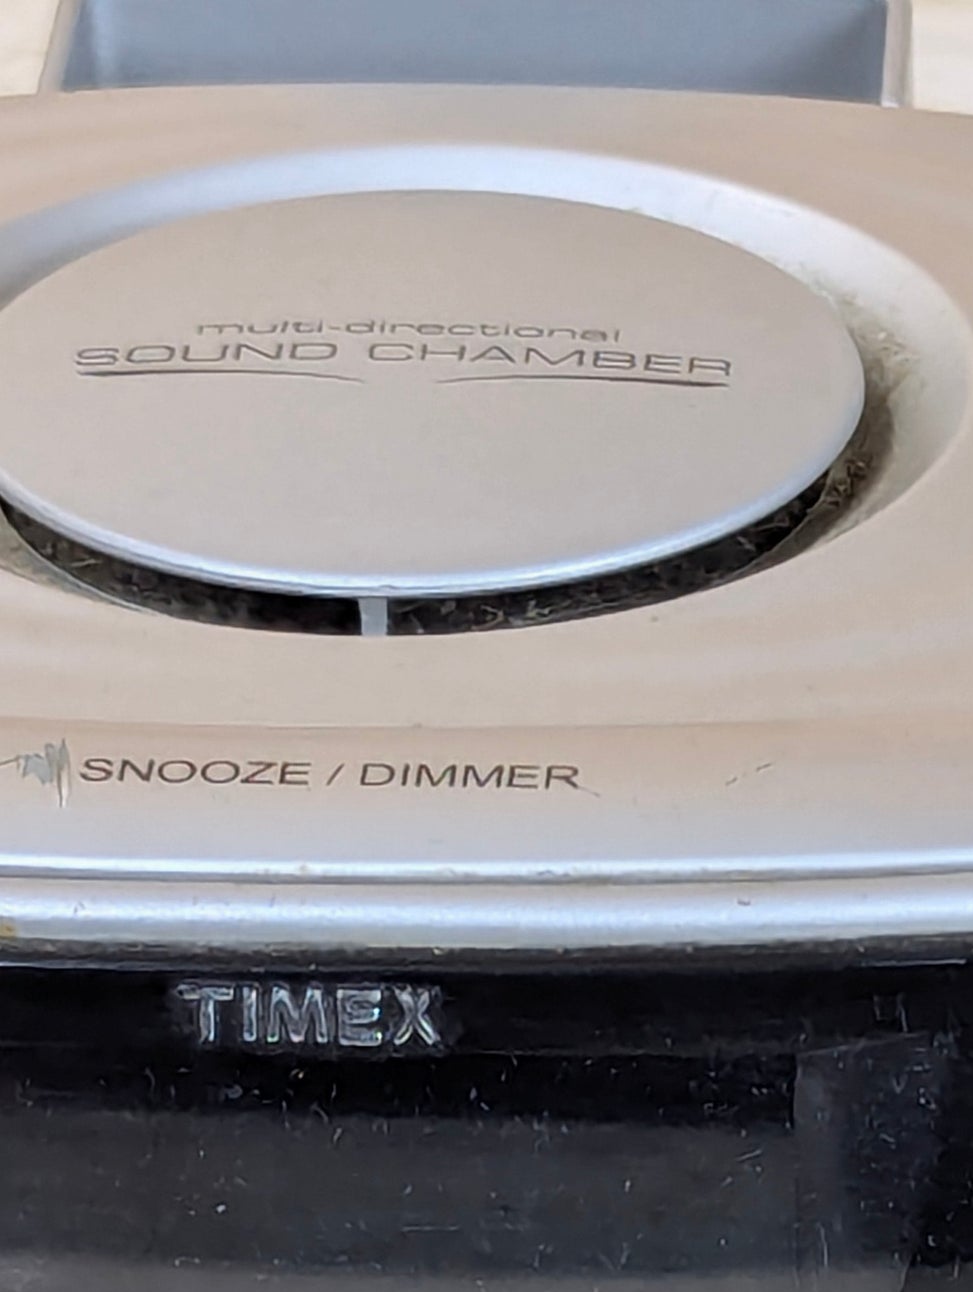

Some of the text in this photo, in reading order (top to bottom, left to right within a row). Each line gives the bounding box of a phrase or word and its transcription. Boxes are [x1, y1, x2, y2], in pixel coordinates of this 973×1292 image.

[197, 318, 622, 343] multi-directional
[75, 342, 732, 377] SOUND CHAMBER
[79, 758, 311, 786] SNOOZE
[359, 763, 582, 789] DIMMER
[178, 982, 442, 1047] TIMEX
